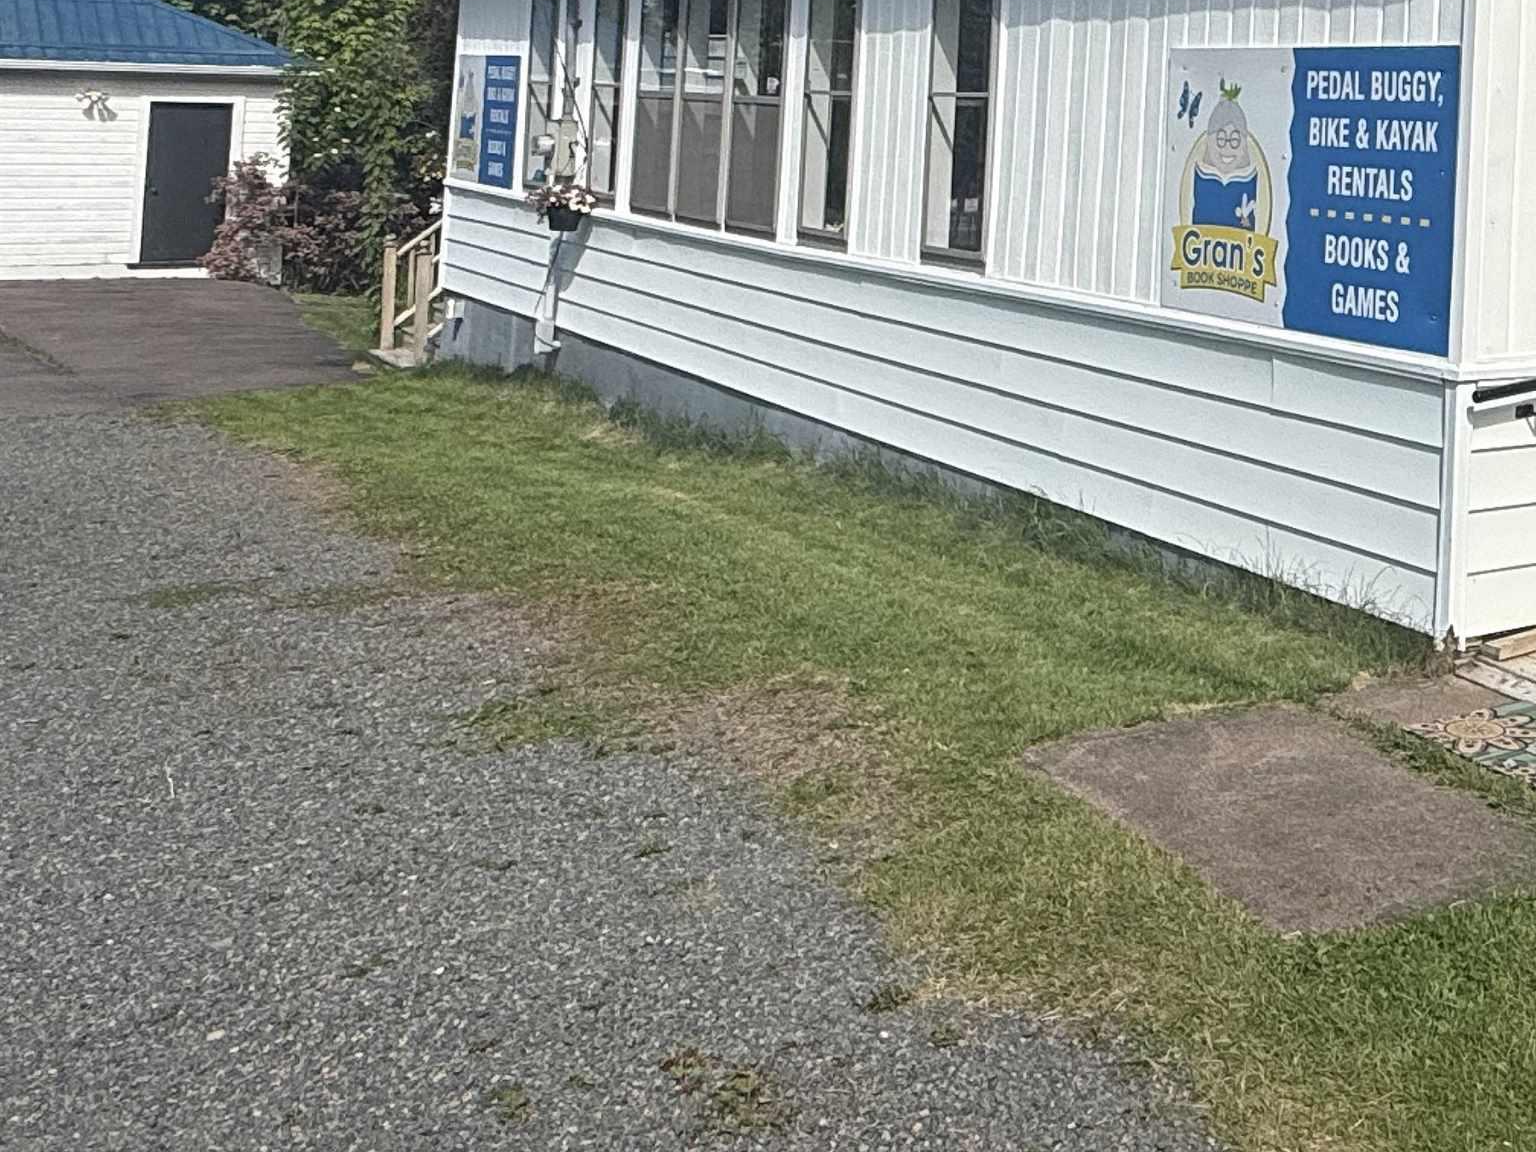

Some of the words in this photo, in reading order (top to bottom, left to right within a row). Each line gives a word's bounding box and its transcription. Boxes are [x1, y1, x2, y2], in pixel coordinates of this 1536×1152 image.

[1306, 70, 1365, 100] PEDAL
[1370, 70, 1443, 107] BUGGY,
[1309, 116, 1350, 148] BIKE
[1355, 118, 1369, 149] &
[1376, 119, 1439, 152] KAYAK
[1327, 165, 1413, 201] RENTALS
[1182, 230, 1265, 277] Gran's
[1324, 234, 1389, 271] BOOKS
[1395, 242, 1410, 274] &
[1187, 271, 1214, 284] BOOK
[1216, 272, 1257, 294] SHOPPE
[1331, 283, 1399, 323] GAMES
